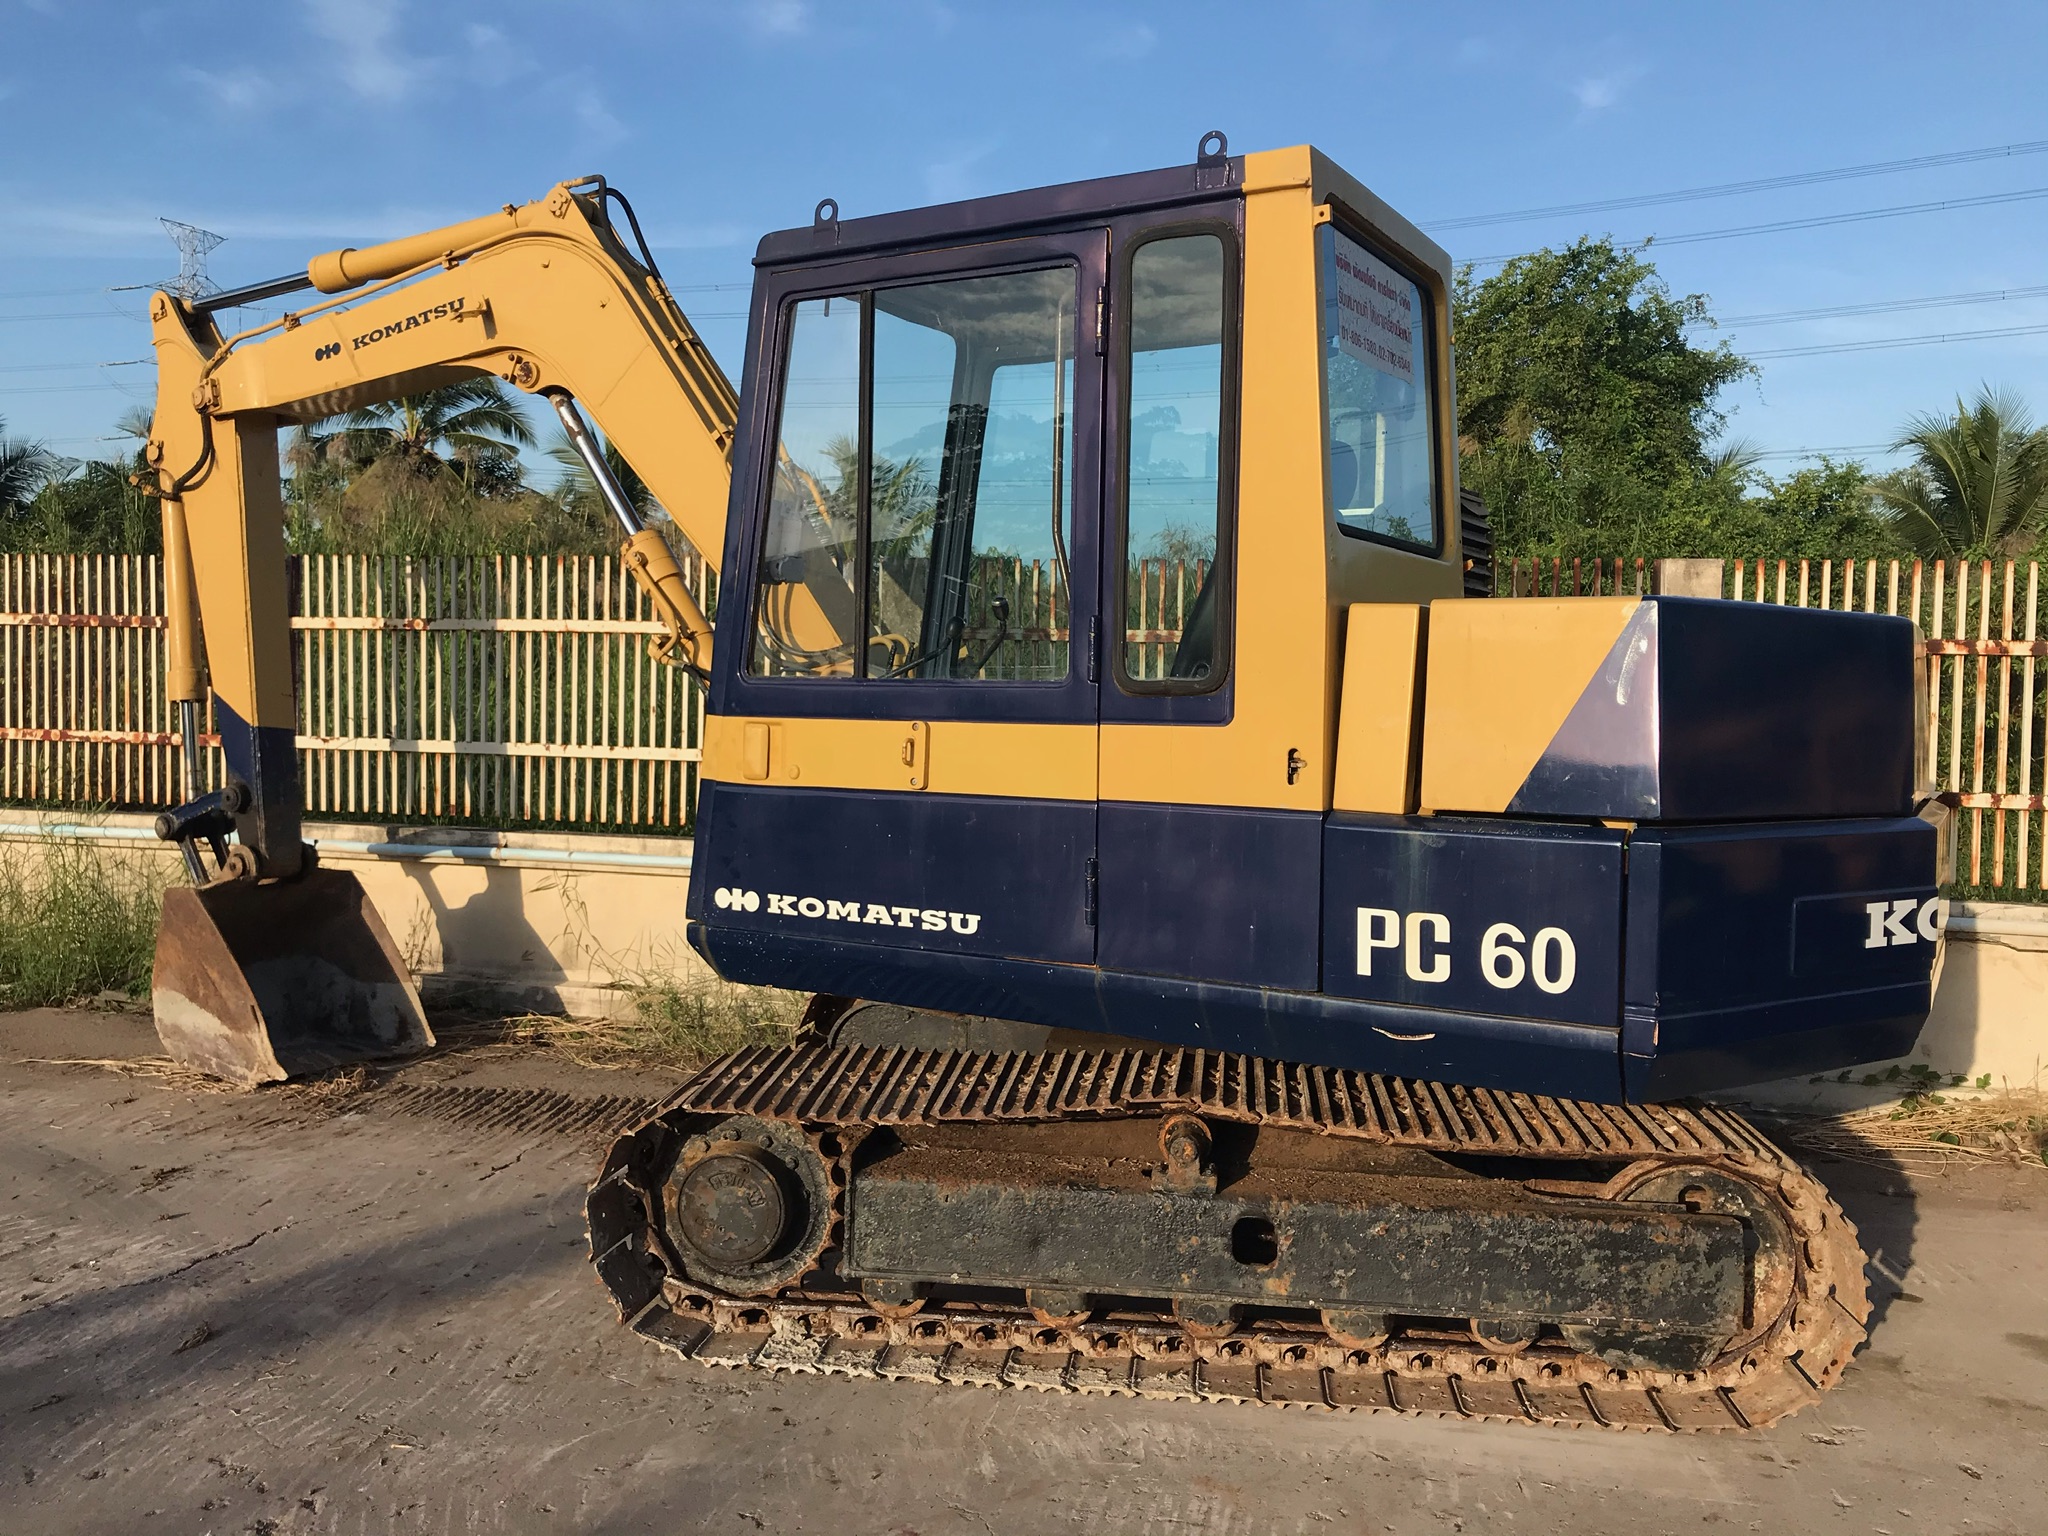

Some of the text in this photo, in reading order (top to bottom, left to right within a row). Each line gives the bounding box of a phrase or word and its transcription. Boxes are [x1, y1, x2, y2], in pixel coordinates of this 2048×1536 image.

[352, 297, 465, 351] KOMATSU
[767, 893, 981, 935] KOMATSU
[1357, 907, 1576, 994] PC 60
